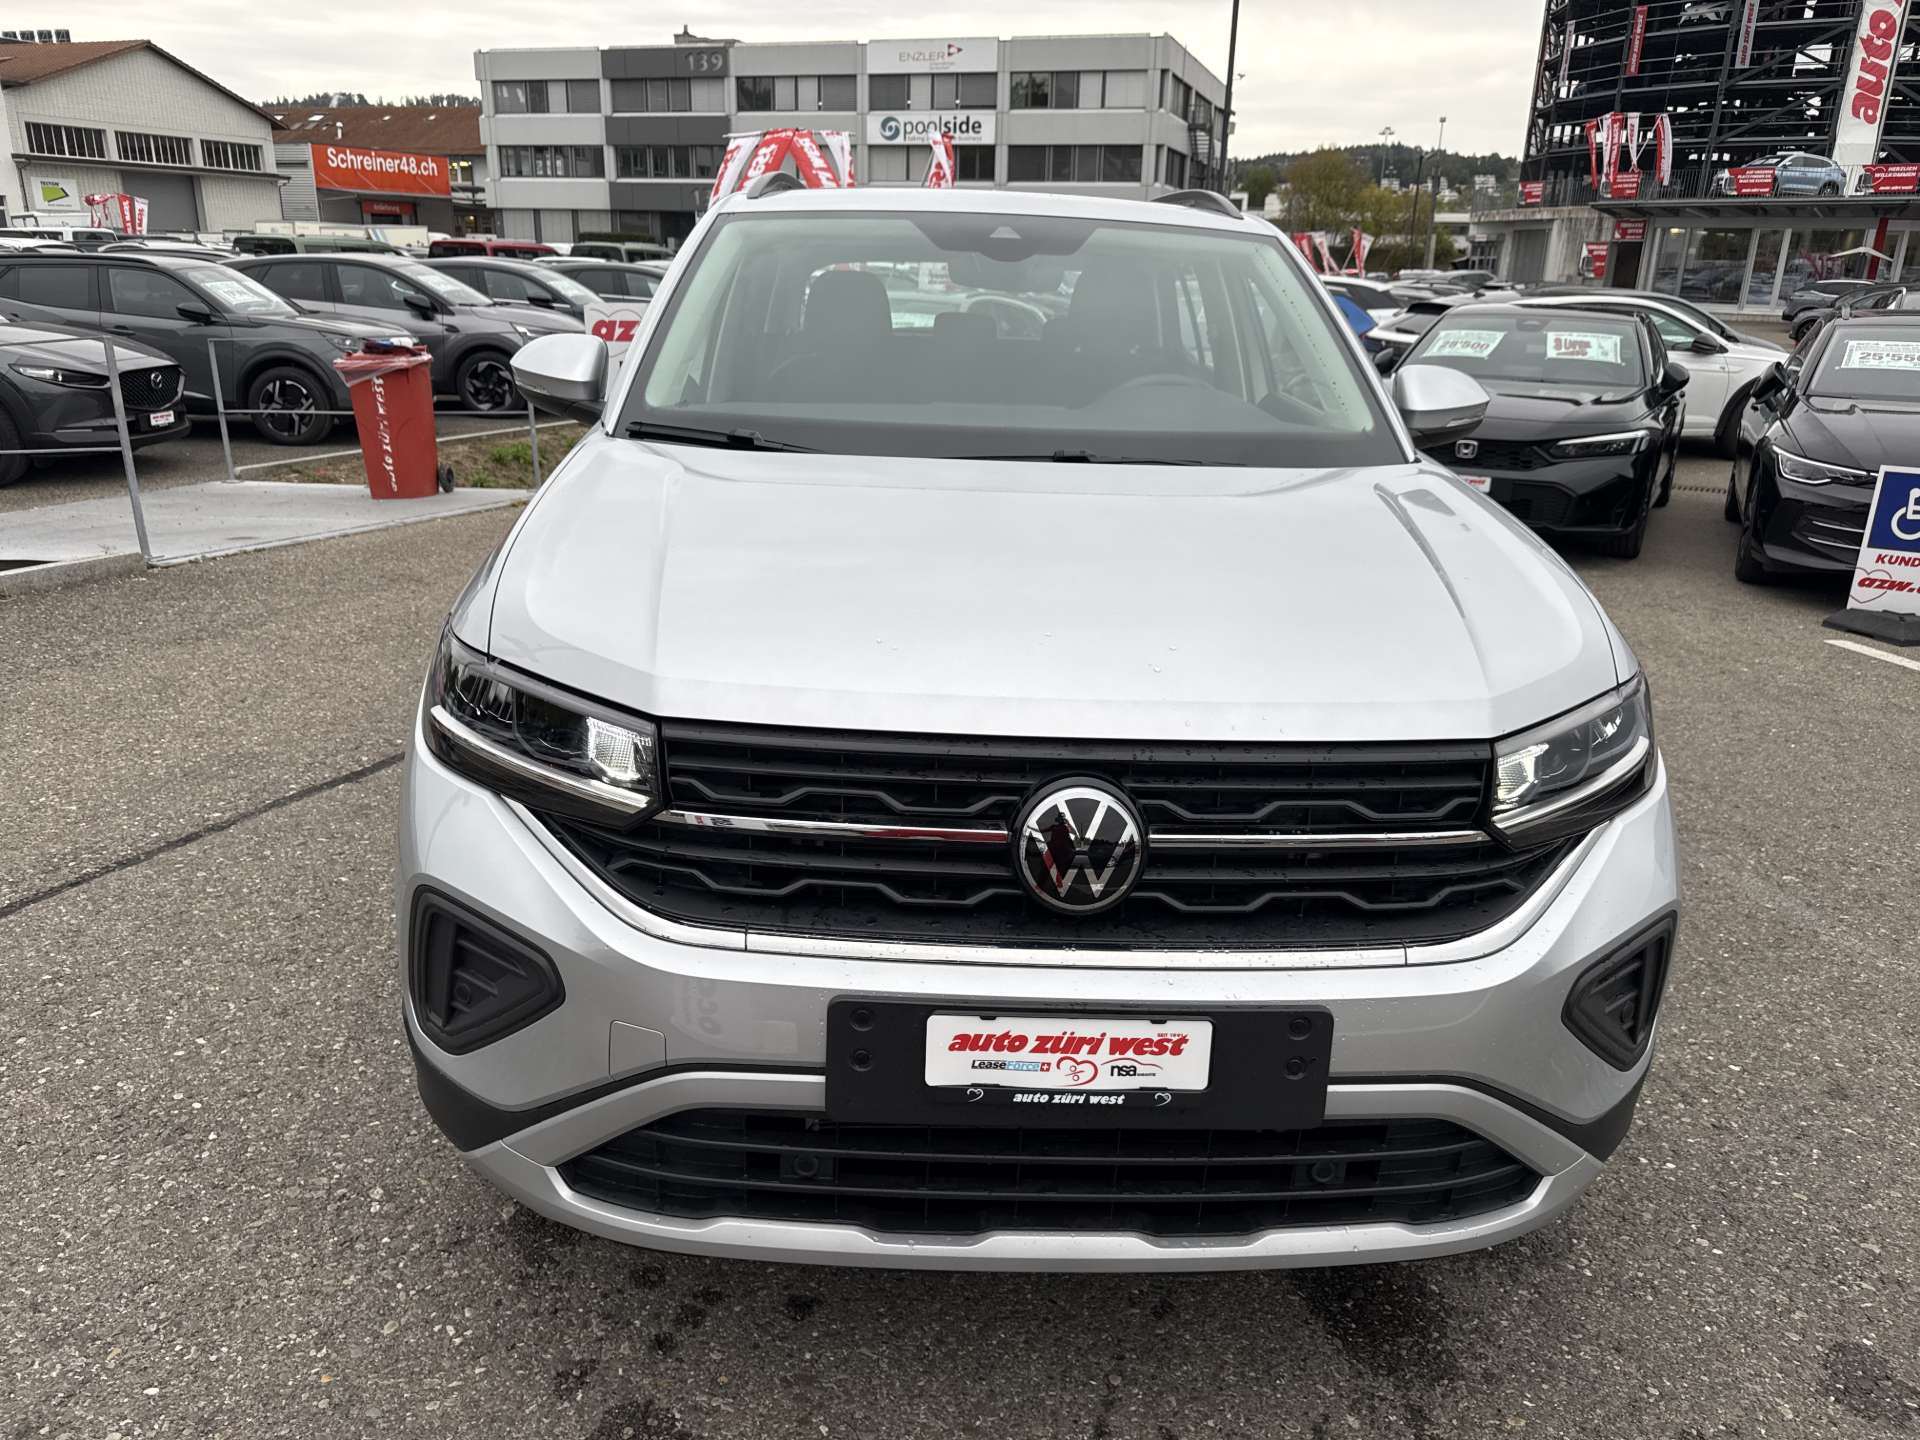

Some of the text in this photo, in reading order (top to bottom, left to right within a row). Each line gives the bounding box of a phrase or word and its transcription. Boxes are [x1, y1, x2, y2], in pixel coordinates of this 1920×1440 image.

[685, 53, 723, 72] 139
[898, 51, 945, 62] ENZLER
[1851, 9, 1897, 124] auto
[903, 115, 983, 142] poolside
[327, 146, 439, 177] Schreiner48.ch
[1859, 351, 1920, 363] 25'55
[948, 1030, 1190, 1057] auto züri west
[971, 1059, 1040, 1072] LeaseForce
[1110, 1065, 1137, 1077] nsa
[1013, 1093, 1125, 1105] auto züri west
